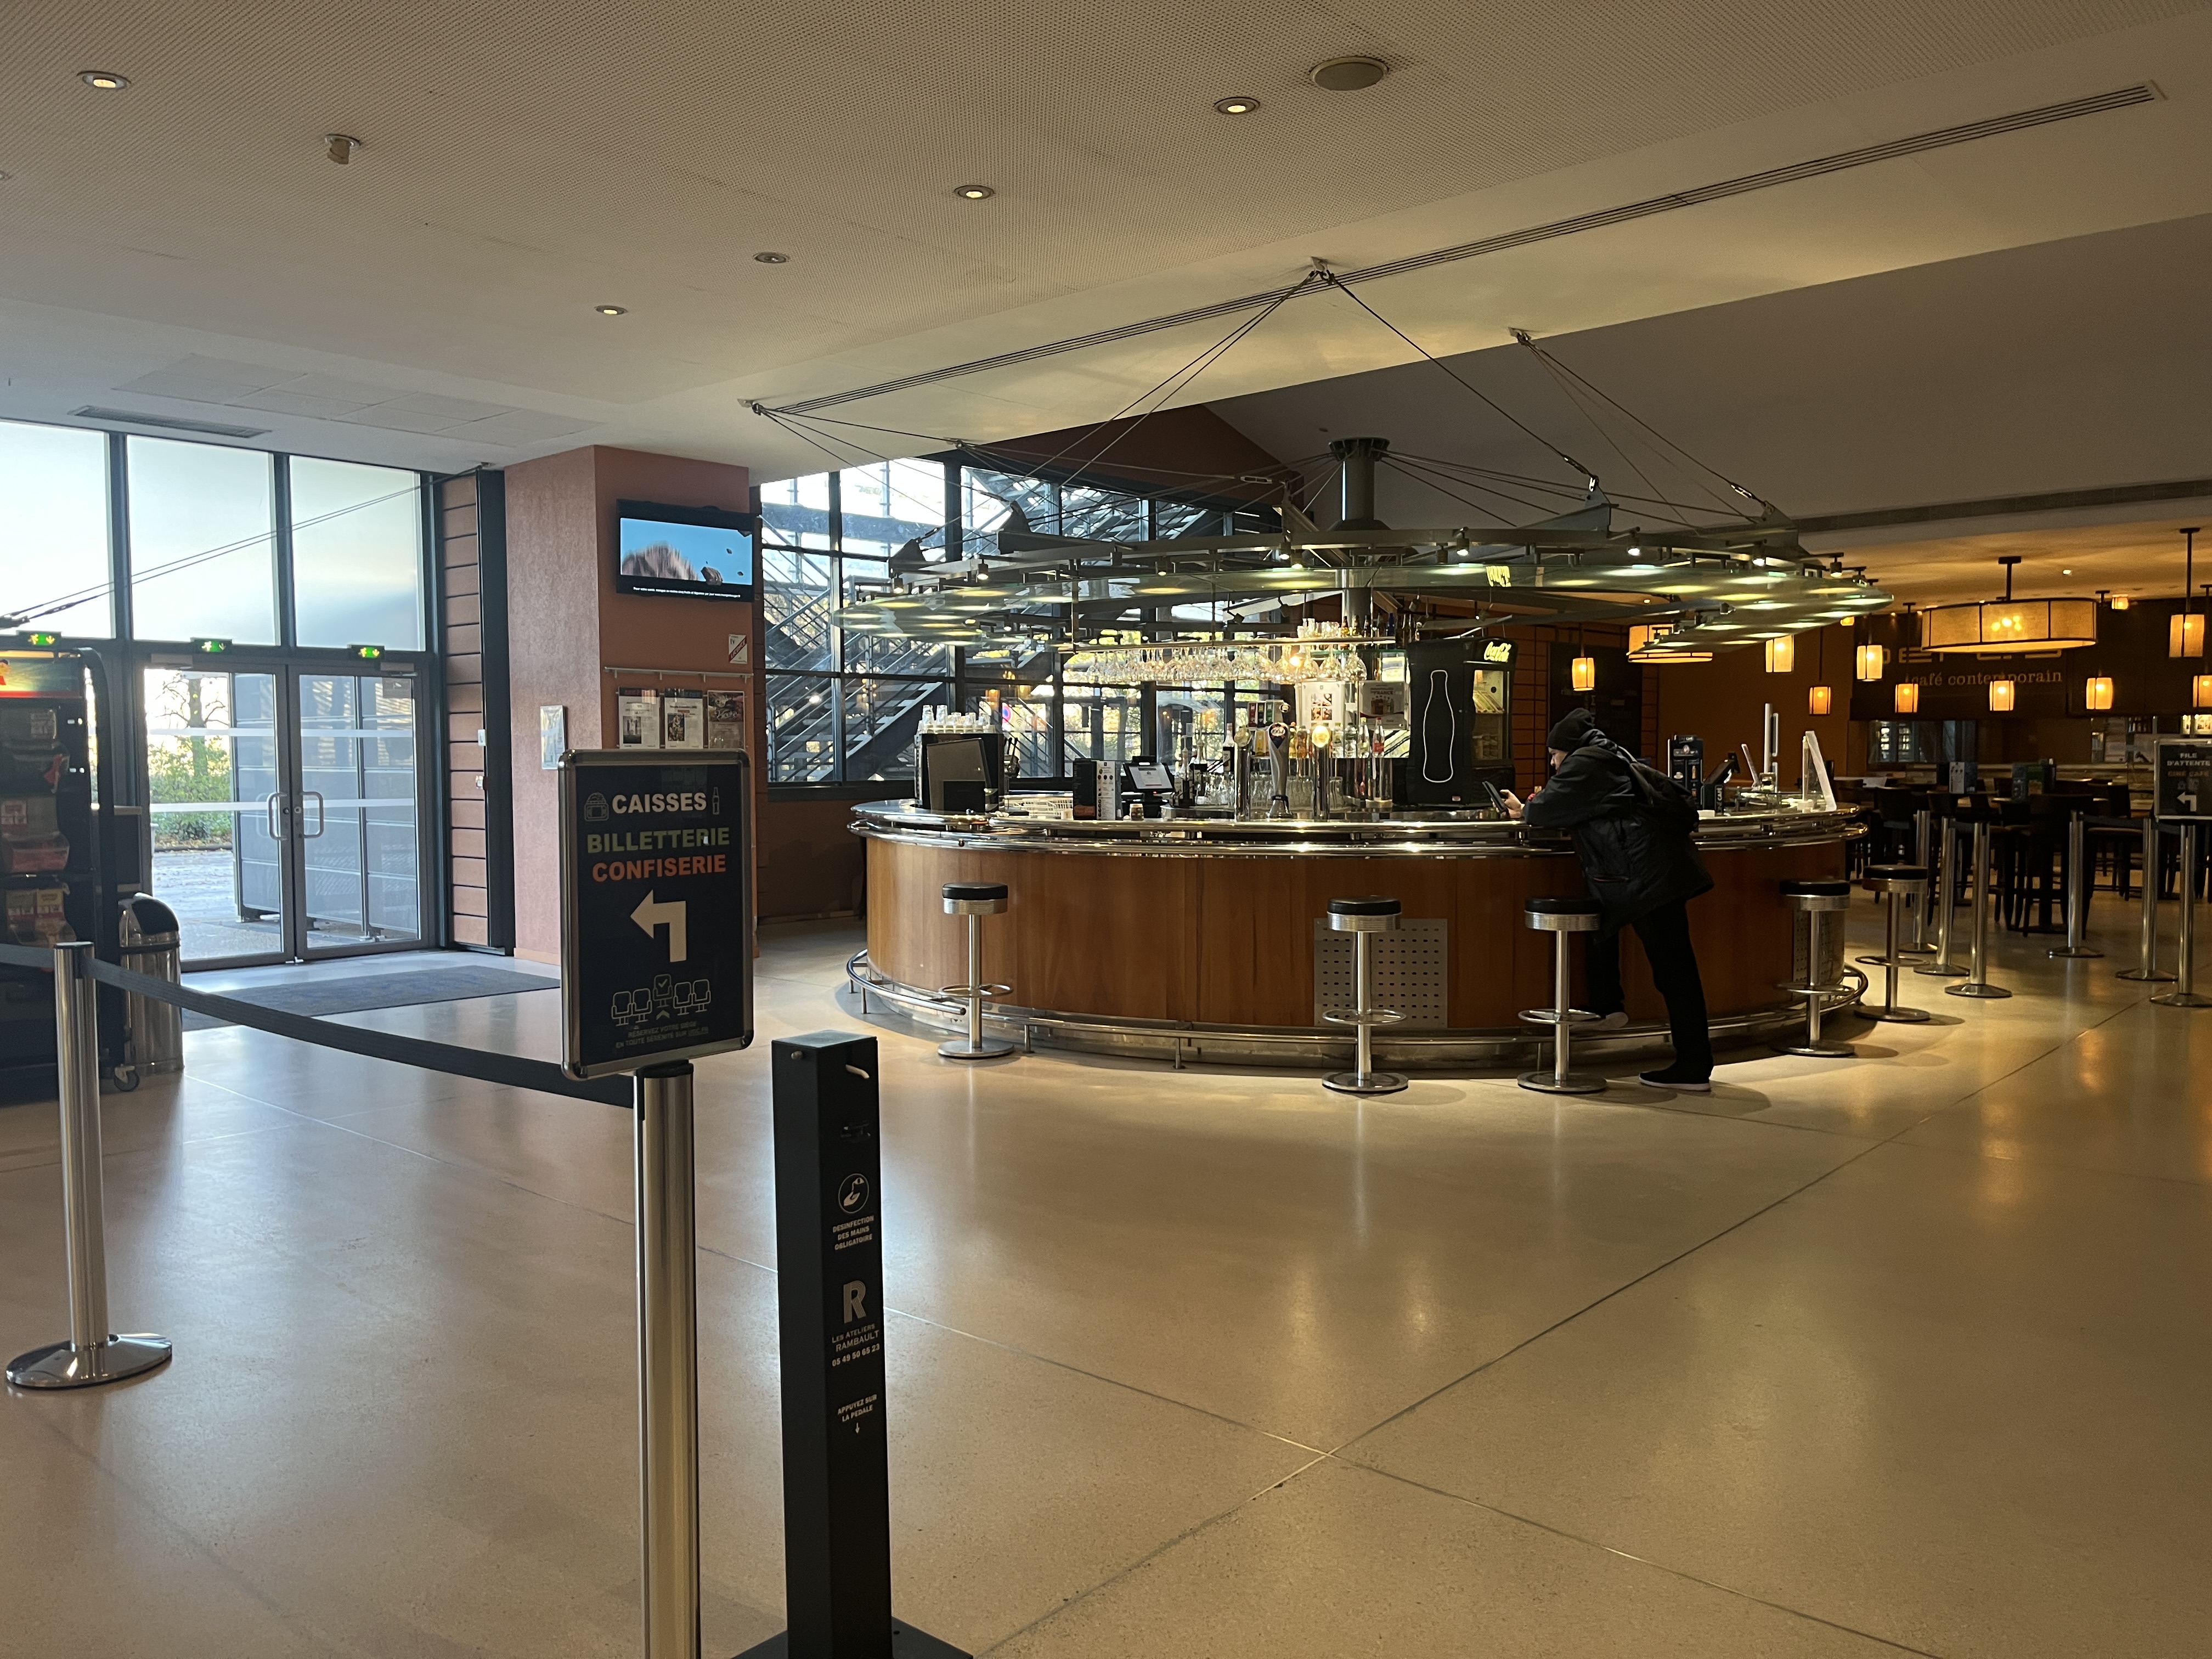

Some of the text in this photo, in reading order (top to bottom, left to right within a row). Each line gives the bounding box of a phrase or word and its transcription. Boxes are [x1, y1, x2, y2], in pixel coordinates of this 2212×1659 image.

[1911, 669, 2062, 686] café contemporain
[612, 792, 707, 814] CAISSES
[587, 827, 730, 854] BILLETTERIE
[592, 854, 726, 882] CONFISERIE
[625, 1037, 645, 1046] TOUTE
[834, 1233, 873, 1251] OBLIGATOIRE
[838, 1225, 870, 1241] DES MAINS
[843, 1280, 866, 1324] R
[832, 1323, 876, 1343] LES ATELIERS
[836, 1329, 880, 1352] RAMBAULT
[832, 1343, 880, 1367] 05 49 50 65 23
[837, 1393, 878, 1415] APPUYEZ SUR
[842, 1414, 850, 1422] LA
